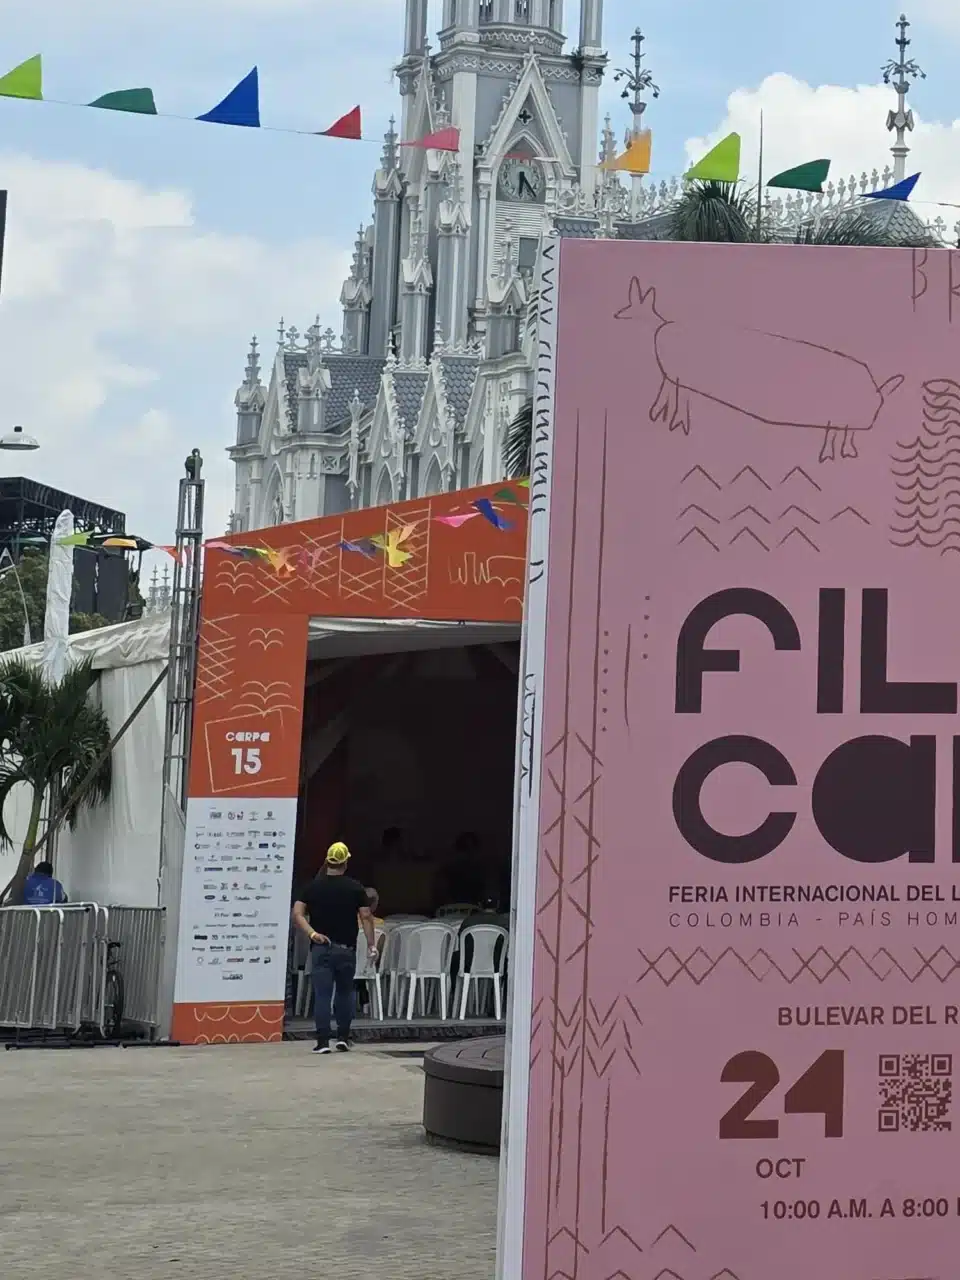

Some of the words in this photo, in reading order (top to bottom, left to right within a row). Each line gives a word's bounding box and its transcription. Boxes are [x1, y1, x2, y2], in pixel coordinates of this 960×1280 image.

[675, 588, 957, 714] FIL
[231, 748, 262, 774] 15
[670, 886, 728, 902] FERIA
[736, 885, 900, 902] INTERNACIONAL
[907, 885, 945, 901] DEL
[670, 913, 798, 927] COLOMBIA
[839, 909, 890, 926] PAÍS
[779, 1006, 884, 1025] BULEVAR
[893, 1006, 936, 1024] DEL
[719, 1050, 844, 1139] 24
[756, 1158, 805, 1178] OCT
[761, 1200, 820, 1219] 10:00
[827, 1199, 872, 1218] A.M.
[880, 1198, 895, 1217] A
[903, 1199, 948, 1217] 8:00
